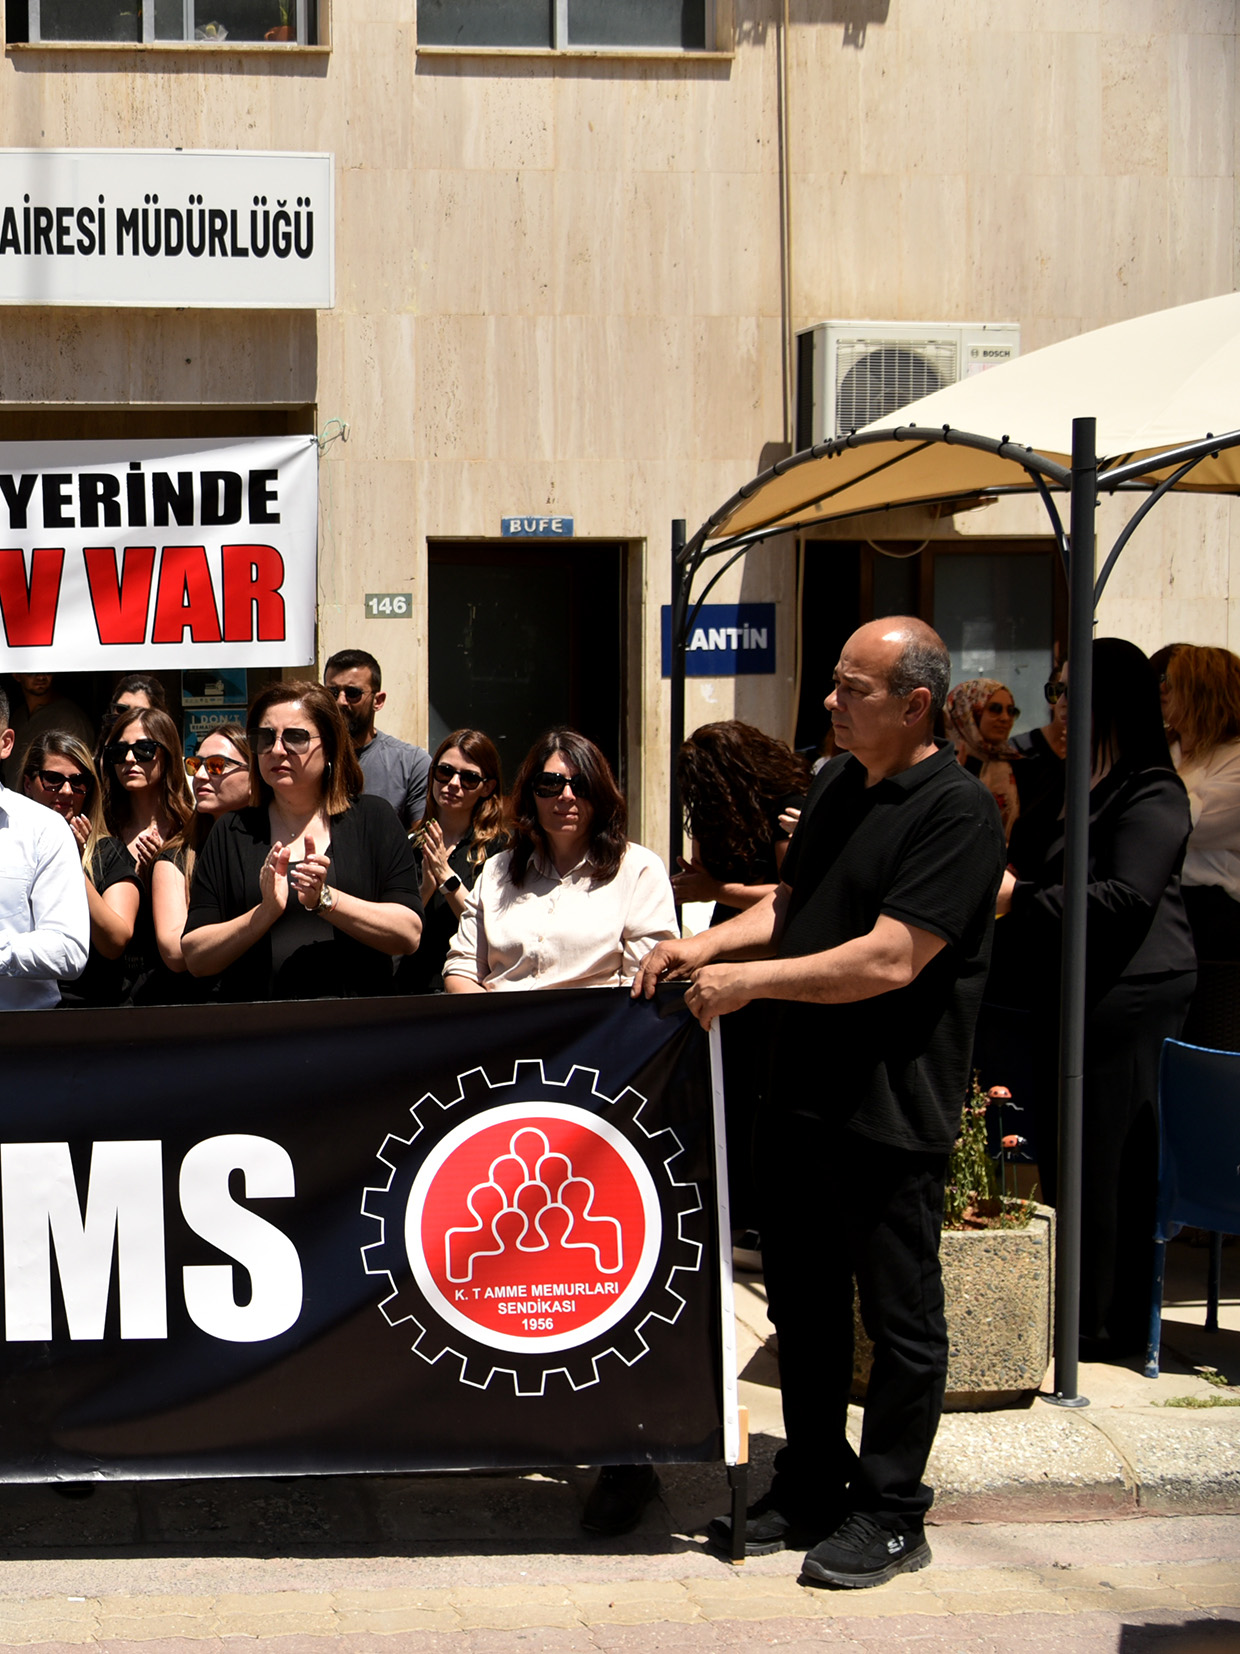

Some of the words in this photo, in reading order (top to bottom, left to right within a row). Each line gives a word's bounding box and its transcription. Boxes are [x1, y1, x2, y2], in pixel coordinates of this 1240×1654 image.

[116, 193, 314, 259] MÜDÜRLÜĞÜ
[983, 350, 1010, 358] BOSCH
[83, 545, 287, 646] VAR
[368, 596, 407, 615] 146
[685, 622, 768, 651] ANTİN
[454, 1289, 468, 1301] K.
[472, 1287, 481, 1300] T
[484, 1285, 528, 1299] AMME
[531, 1282, 619, 1297] MEMURLARI
[497, 1299, 576, 1315] SENDİKASI
[521, 1318, 554, 1331] 1956
